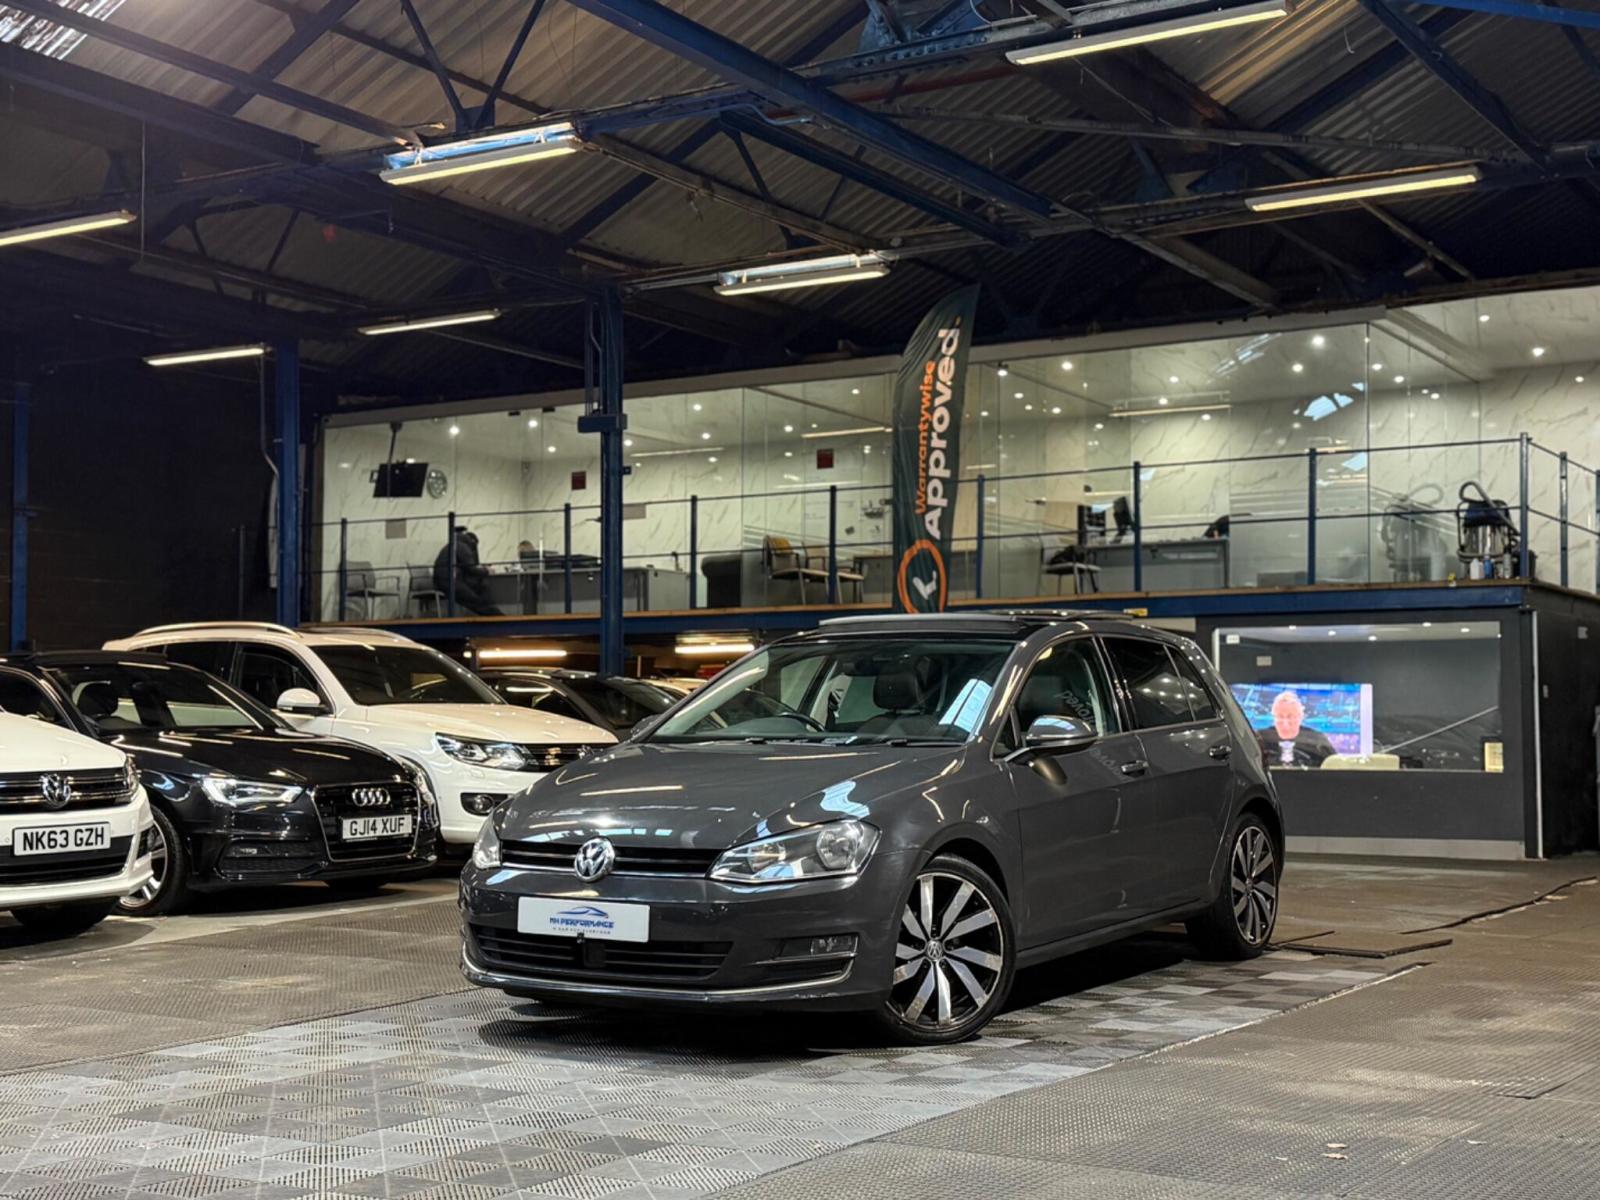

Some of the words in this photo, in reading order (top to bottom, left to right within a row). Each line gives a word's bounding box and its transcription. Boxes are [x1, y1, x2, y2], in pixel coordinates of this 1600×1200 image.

[915, 360, 936, 514] Warrantywise
[22, 829, 69, 851] NK63
[74, 826, 105, 848] GZH
[349, 819, 378, 836] GJ14
[381, 816, 405, 833] XUF
